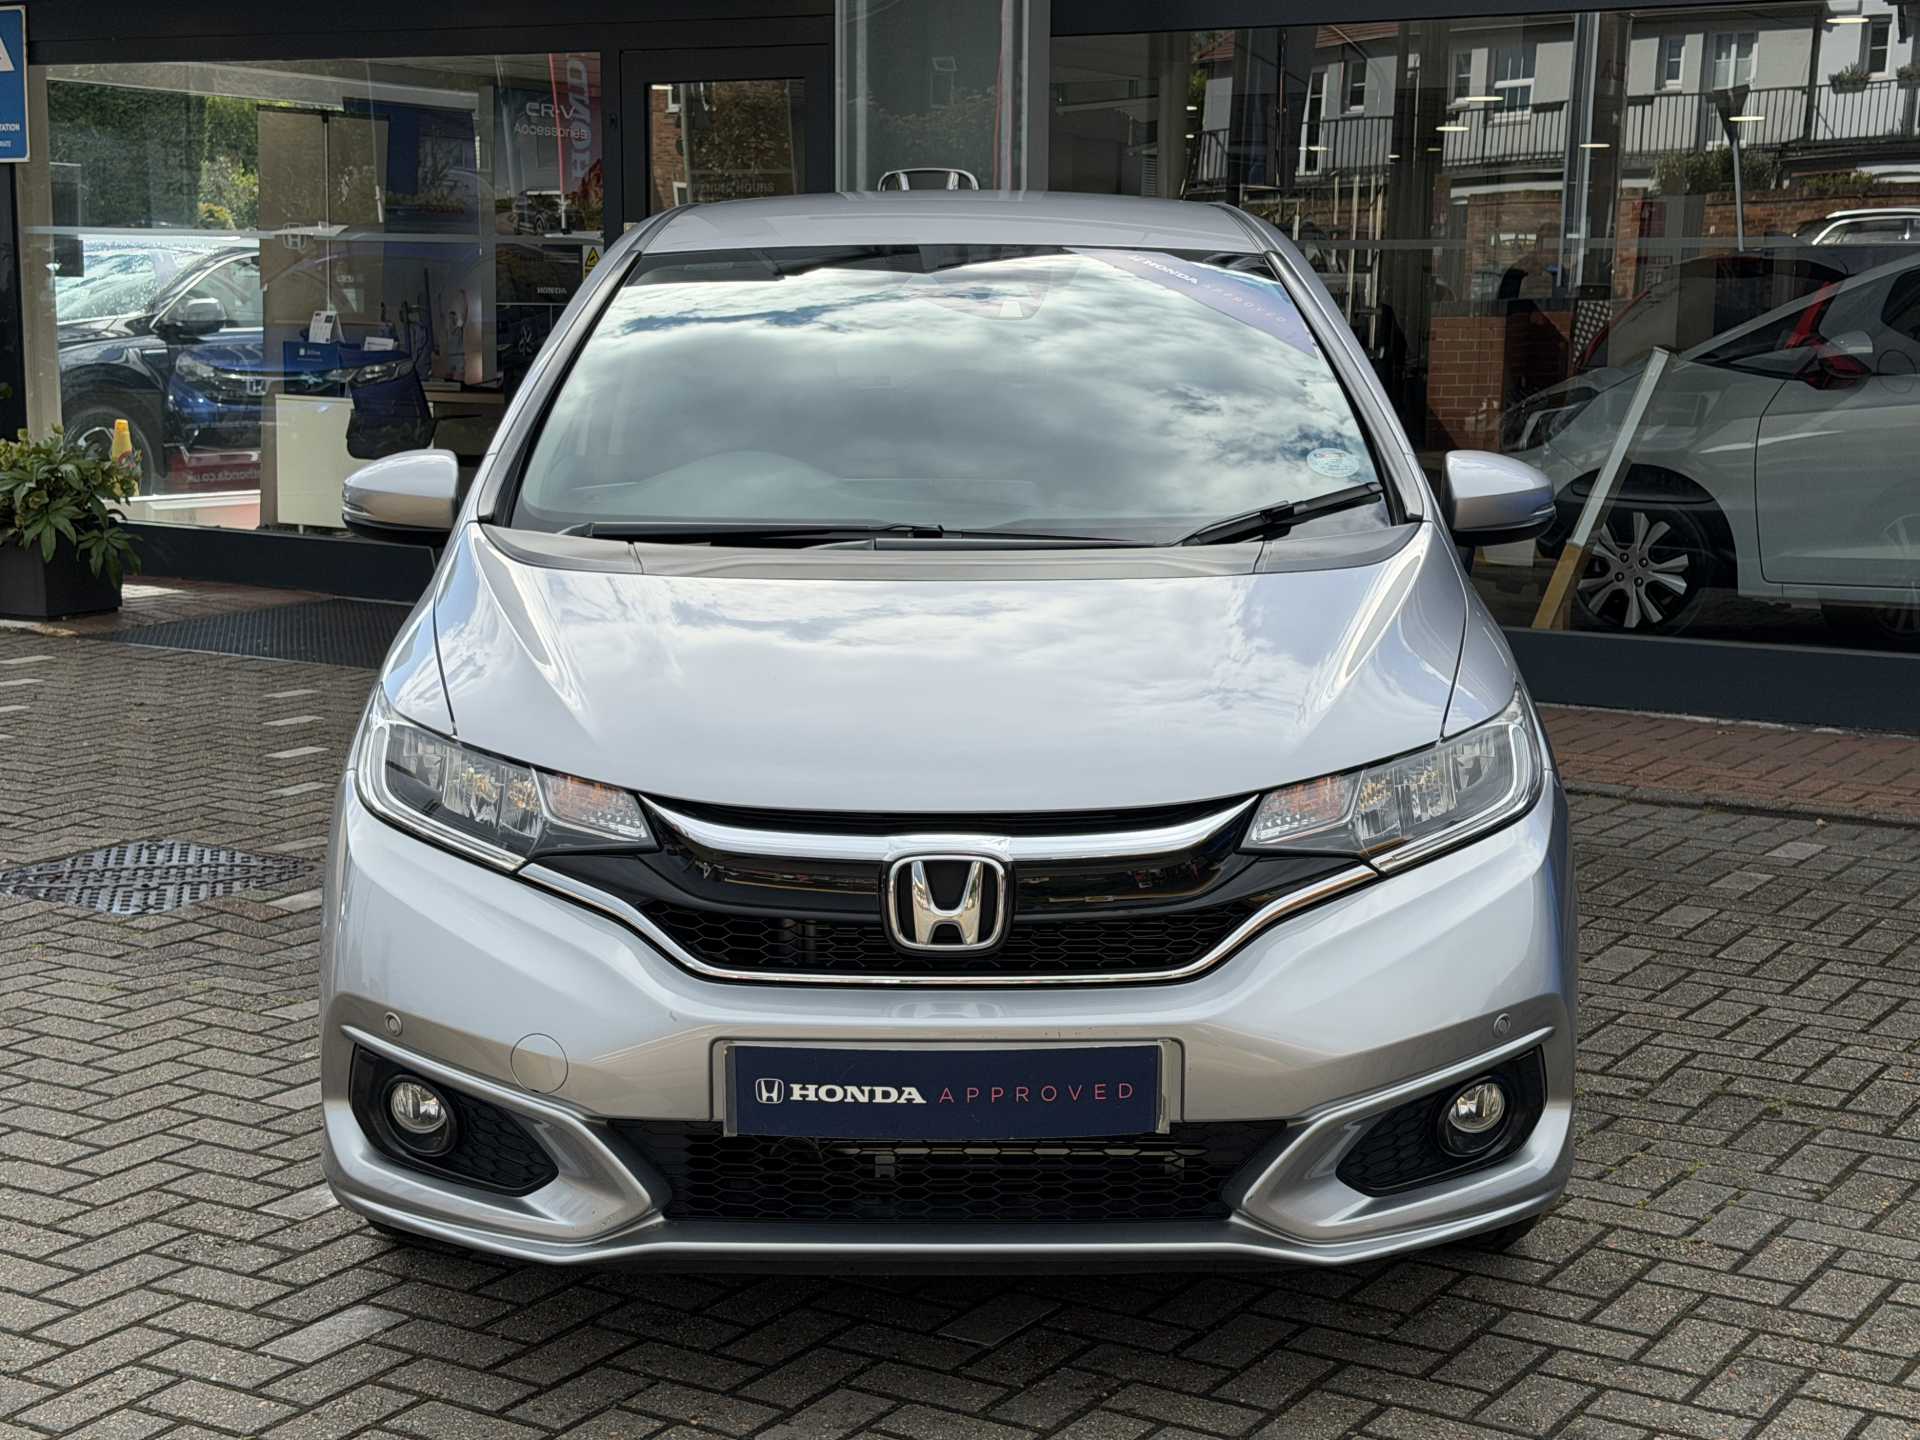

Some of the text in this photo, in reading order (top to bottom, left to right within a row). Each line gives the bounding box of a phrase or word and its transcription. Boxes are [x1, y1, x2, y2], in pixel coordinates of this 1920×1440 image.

[526, 102, 577, 119] CR-V
[513, 122, 588, 139] Accessories
[789, 1083, 927, 1104] HONDA
[938, 1082, 1135, 1104] APPROVED
